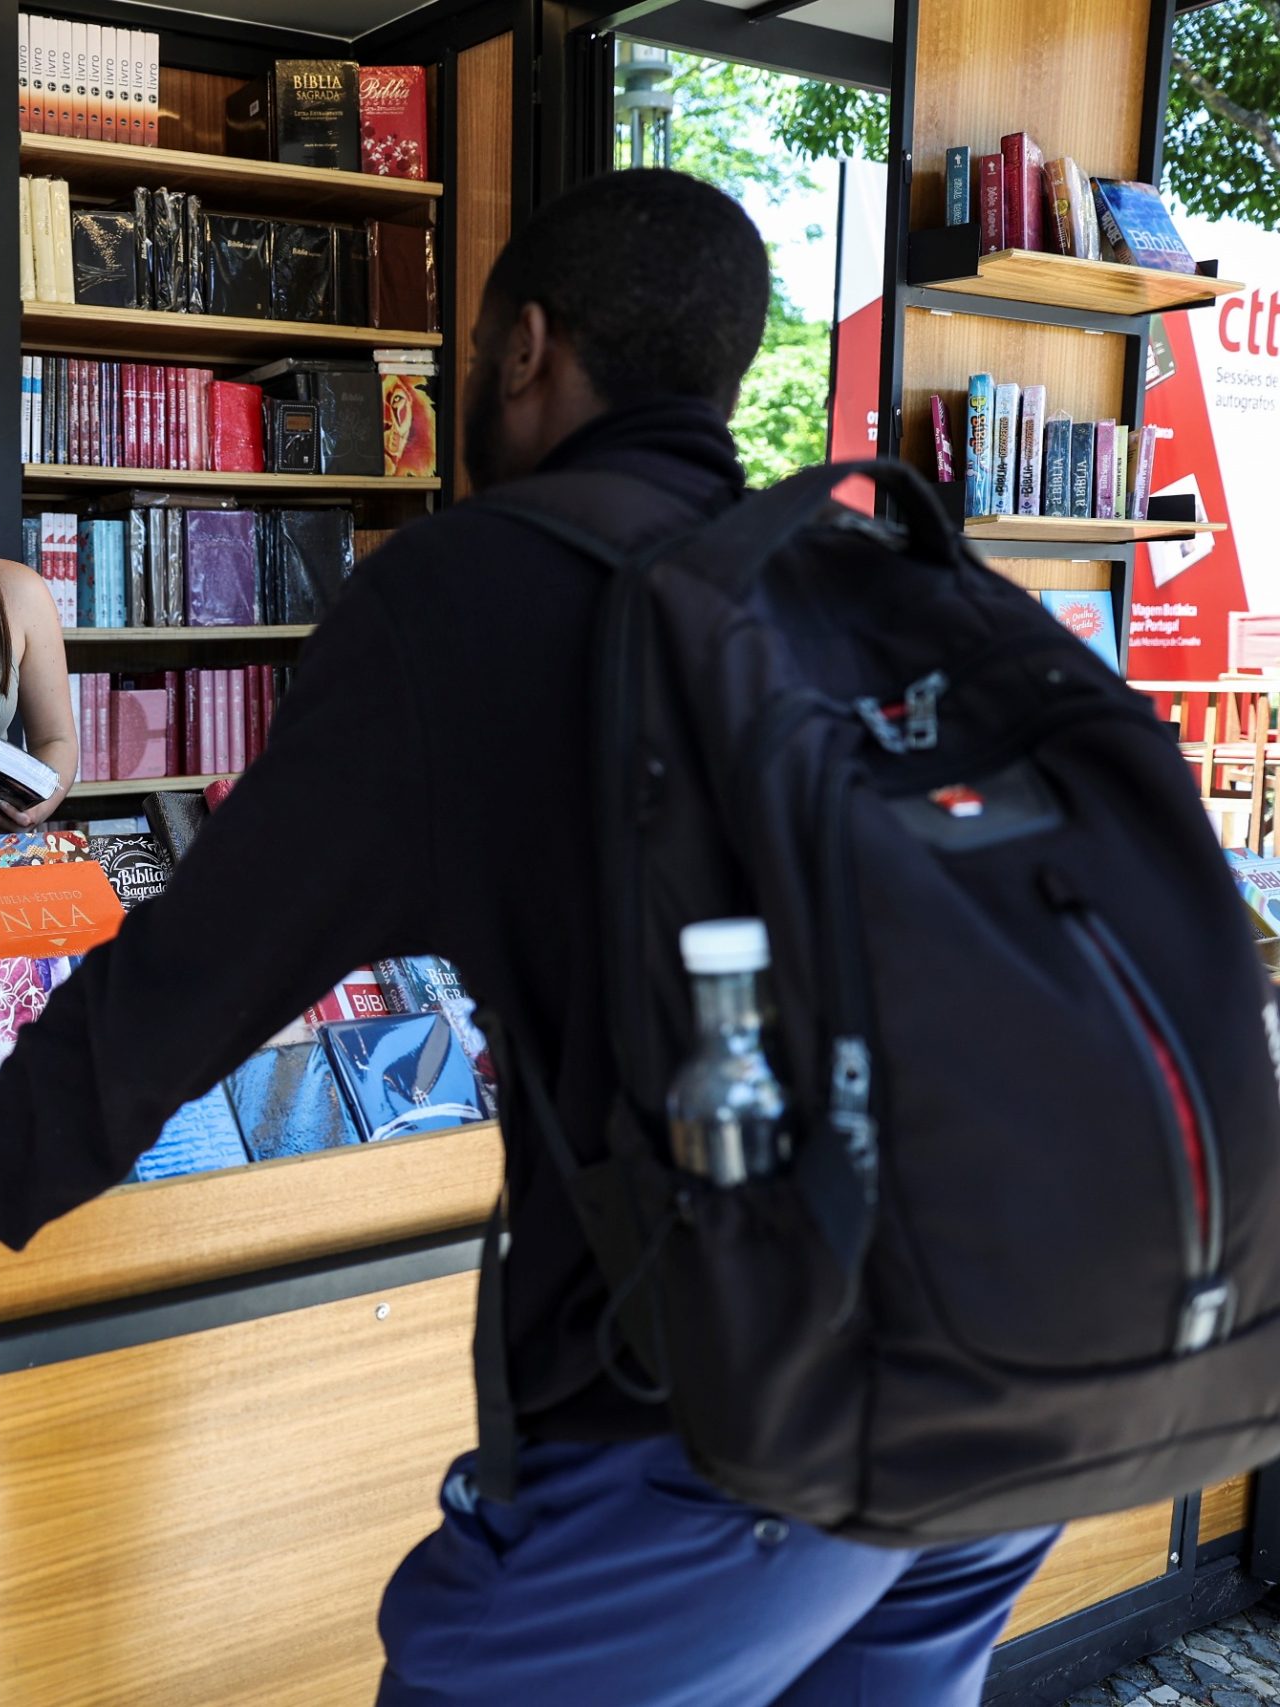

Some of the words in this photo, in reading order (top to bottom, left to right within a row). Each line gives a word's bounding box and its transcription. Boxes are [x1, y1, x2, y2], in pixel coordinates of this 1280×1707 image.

[19, 45, 28, 73] livro
[32, 47, 42, 75] livro
[46, 49, 56, 77] livro
[60, 51, 70, 79] livro
[75, 53, 86, 81] livro
[89, 54, 99, 82] livro
[104, 58, 114, 85] livro
[118, 59, 128, 87] livro
[132, 61, 143, 88] livro
[147, 63, 157, 90] livro
[293, 72, 342, 89] BÍBLIA
[296, 90, 340, 101] SAGRADA
[359, 77, 410, 100] Bíblia
[1127, 229, 1185, 252] Bíblia
[1218, 288, 1280, 357] ctt
[1052, 458, 1063, 494] BÍBLIA
[1074, 460, 1087, 496] BÍBLIA
[1131, 603, 1162, 618] Viagem
[1130, 622, 1144, 634] por
[1145, 619, 1180, 635] Portugal
[118, 866, 167, 886] Bíblia
[1247, 869, 1280, 890] BÍBL
[0, 904, 96, 934] NAA
[426, 966, 462, 986] BÍBL
[425, 983, 466, 1002] SAGR
